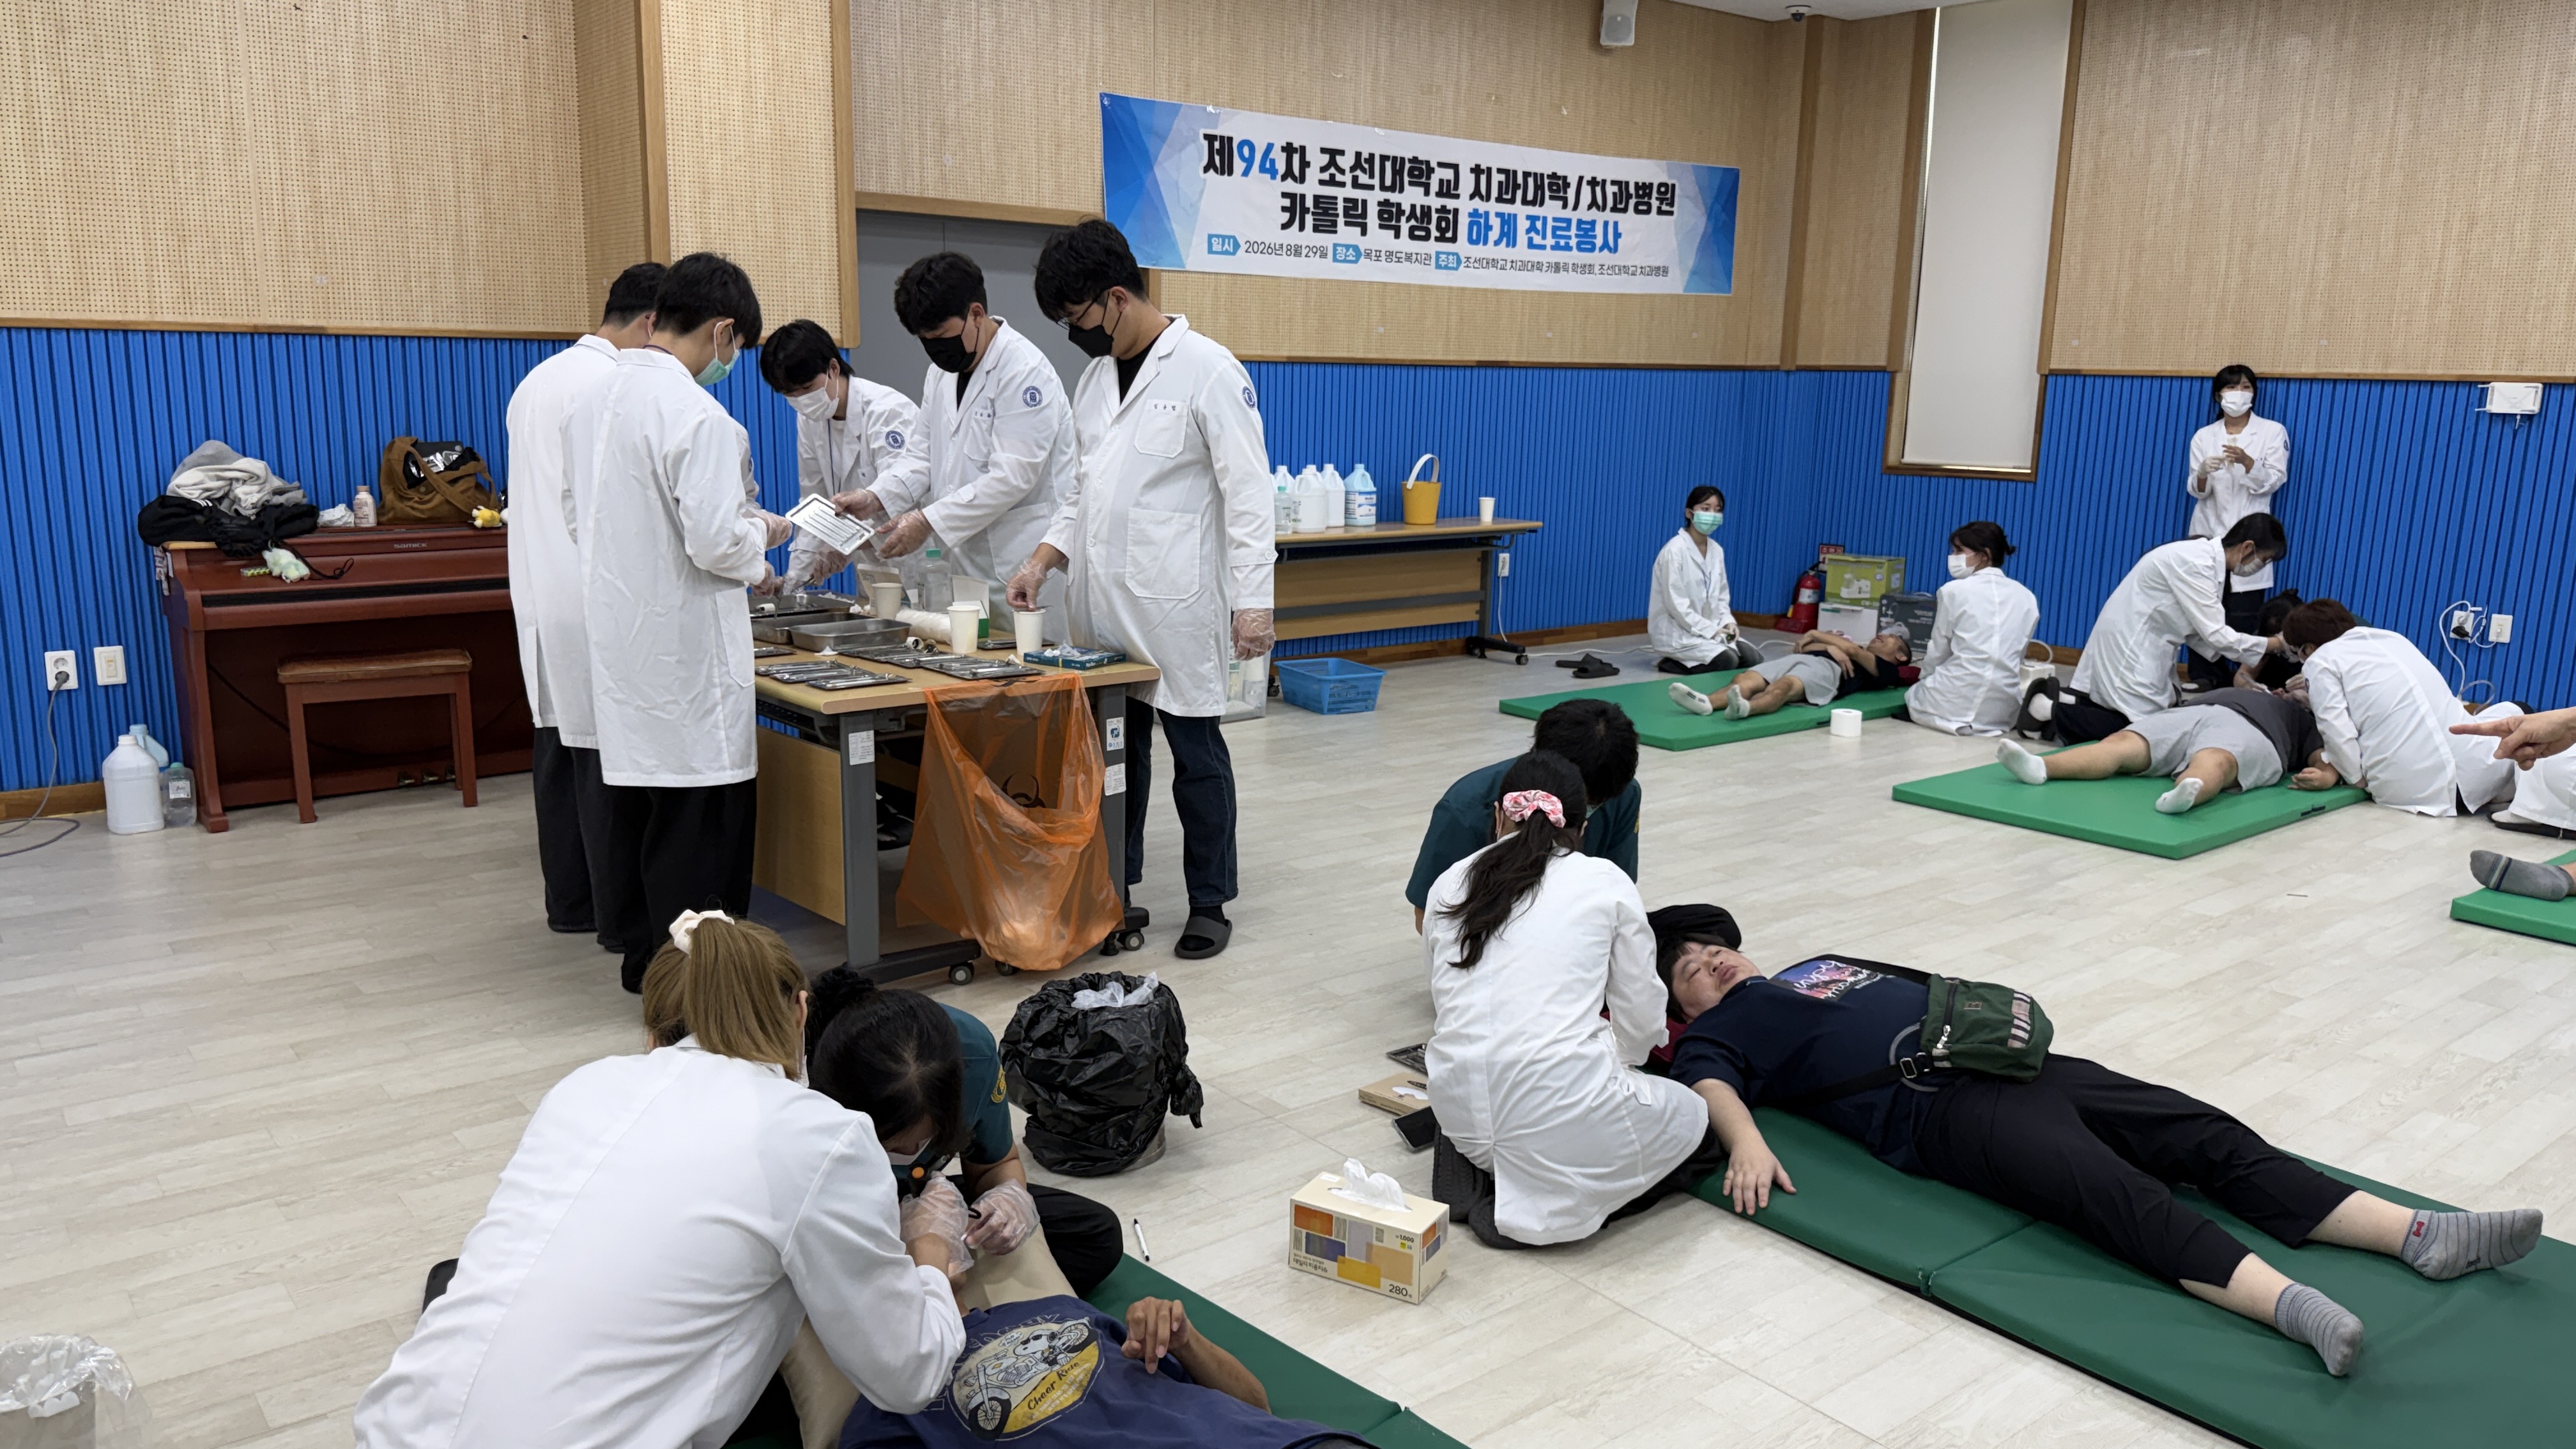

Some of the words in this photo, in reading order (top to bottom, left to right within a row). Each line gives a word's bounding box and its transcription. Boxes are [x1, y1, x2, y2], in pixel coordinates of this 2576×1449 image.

[1203, 133, 1310, 185] 제94차
[1318, 146, 1460, 200] 조선대학교
[1469, 164, 1676, 217] 치과대학/치과병원
[1280, 191, 1368, 237] 카톨릭
[1377, 199, 1459, 244] 학생회
[1466, 208, 1519, 249] 하계
[1524, 214, 1622, 254] 진료봉사
[1211, 237, 1234, 253] 일시
[1245, 240, 1284, 256] 2026년
[1285, 243, 1303, 258] 8월
[1304, 245, 1328, 259] 29일
[1335, 245, 1356, 261] 장소
[1363, 249, 1383, 263] 목포
[1384, 250, 1432, 266] 명도복지관
[1438, 254, 1457, 268] 주최
[1463, 256, 1508, 271] 조선대학교
[1509, 259, 1544, 273] 치과대학
[1545, 261, 1570, 275] 카톨릭
[1570, 262, 1597, 276] 학생회,
[1598, 263, 1638, 277] 조선대학교
[1639, 264, 1669, 277] 치과병원
[1027, 1380, 1056, 1410] Cheer
